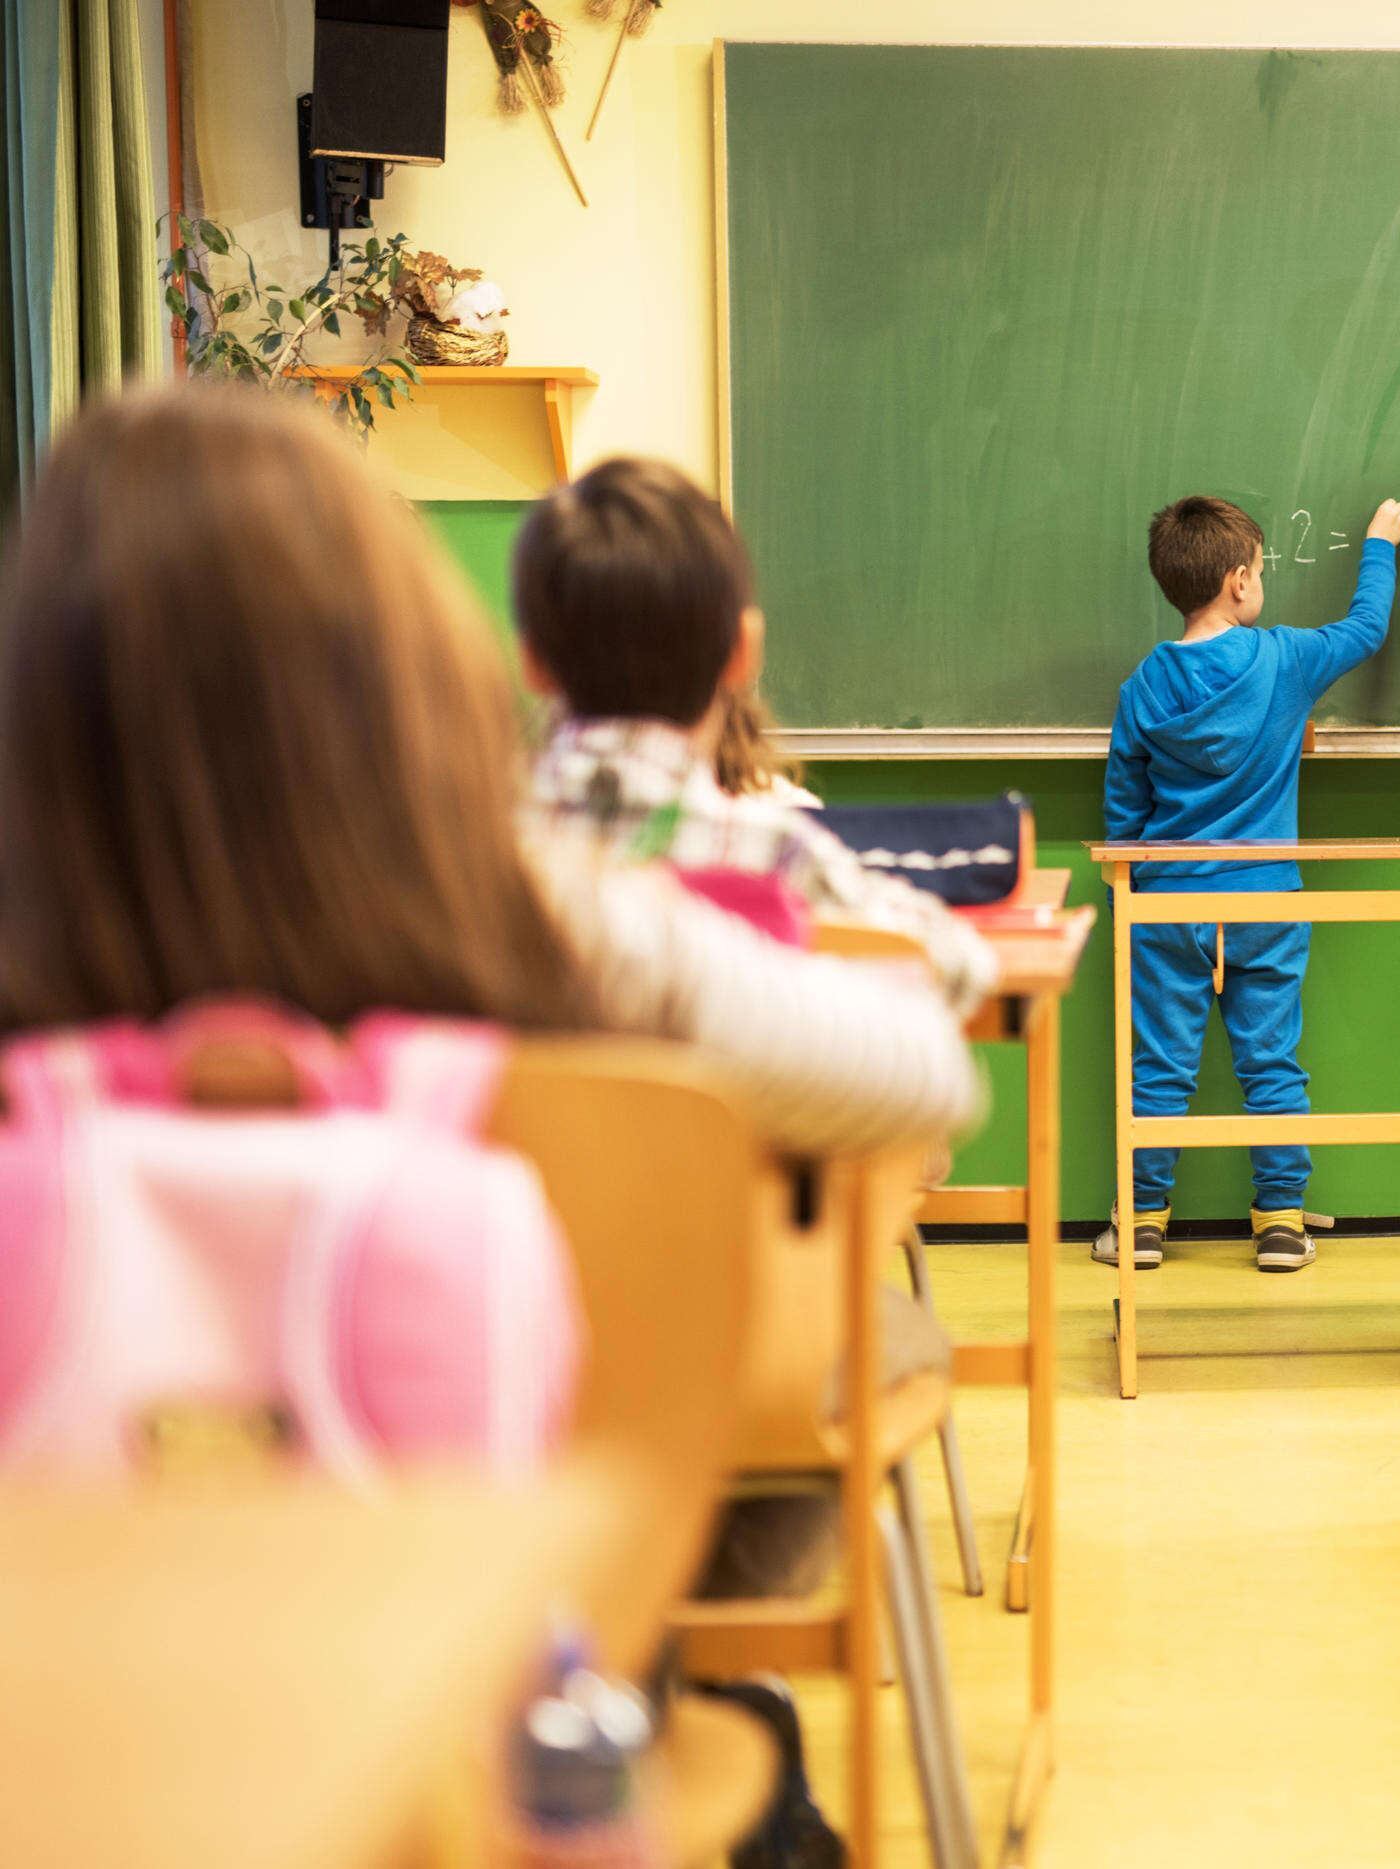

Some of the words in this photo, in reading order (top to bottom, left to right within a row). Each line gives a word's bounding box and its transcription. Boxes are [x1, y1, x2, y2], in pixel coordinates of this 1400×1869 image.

[1262, 546, 1282, 571] +
[1291, 509, 1316, 563] 2
[1328, 531, 1350, 551] =
